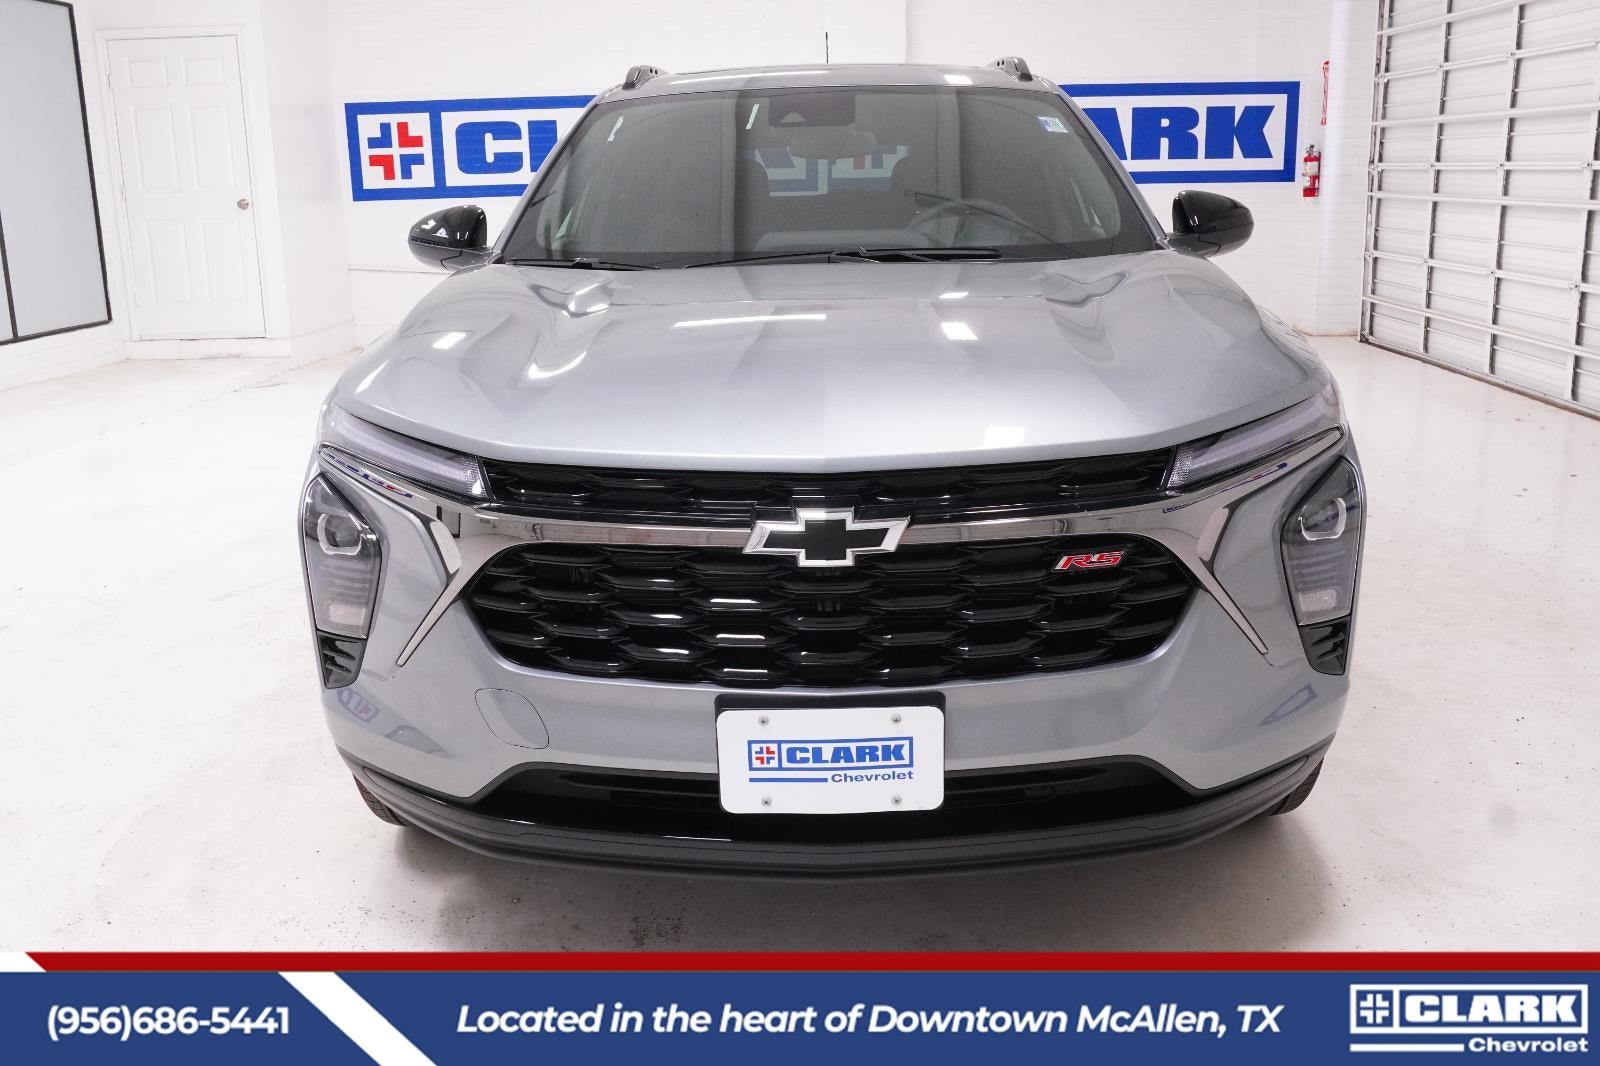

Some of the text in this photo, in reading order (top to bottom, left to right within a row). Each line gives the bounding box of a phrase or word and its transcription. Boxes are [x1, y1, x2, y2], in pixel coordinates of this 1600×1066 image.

[1054, 551, 1125, 570] RS
[786, 744, 905, 764] CLARK
[831, 770, 914, 783] Chevrolet
